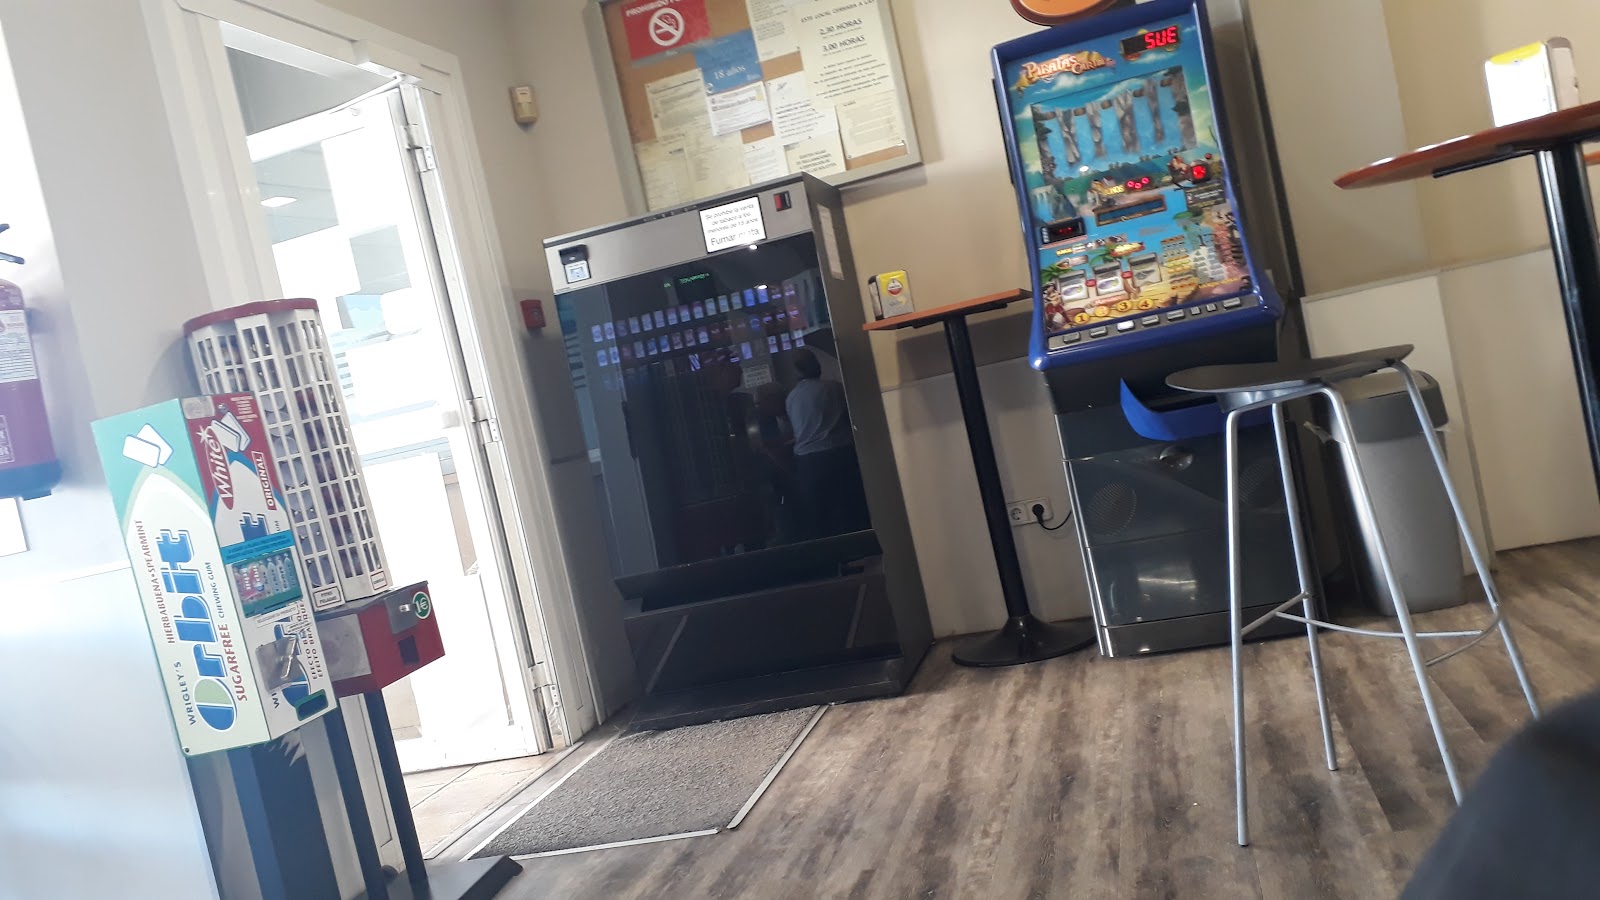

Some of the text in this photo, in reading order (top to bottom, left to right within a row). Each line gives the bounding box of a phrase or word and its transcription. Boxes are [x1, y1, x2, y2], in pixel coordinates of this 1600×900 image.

[836, 18, 862, 29] HORAS
[839, 35, 866, 47] HORAS
[711, 234, 736, 246] Fumar
[208, 435, 234, 499] White
[255, 457, 275, 507] ORIGINAL
[415, 597, 429, 613] 1€
[204, 562, 247, 702] SUGARFREE CHEWING GUM
[306, 649, 317, 679] EFECTO
[174, 661, 196, 726] WRIGLEY'S
